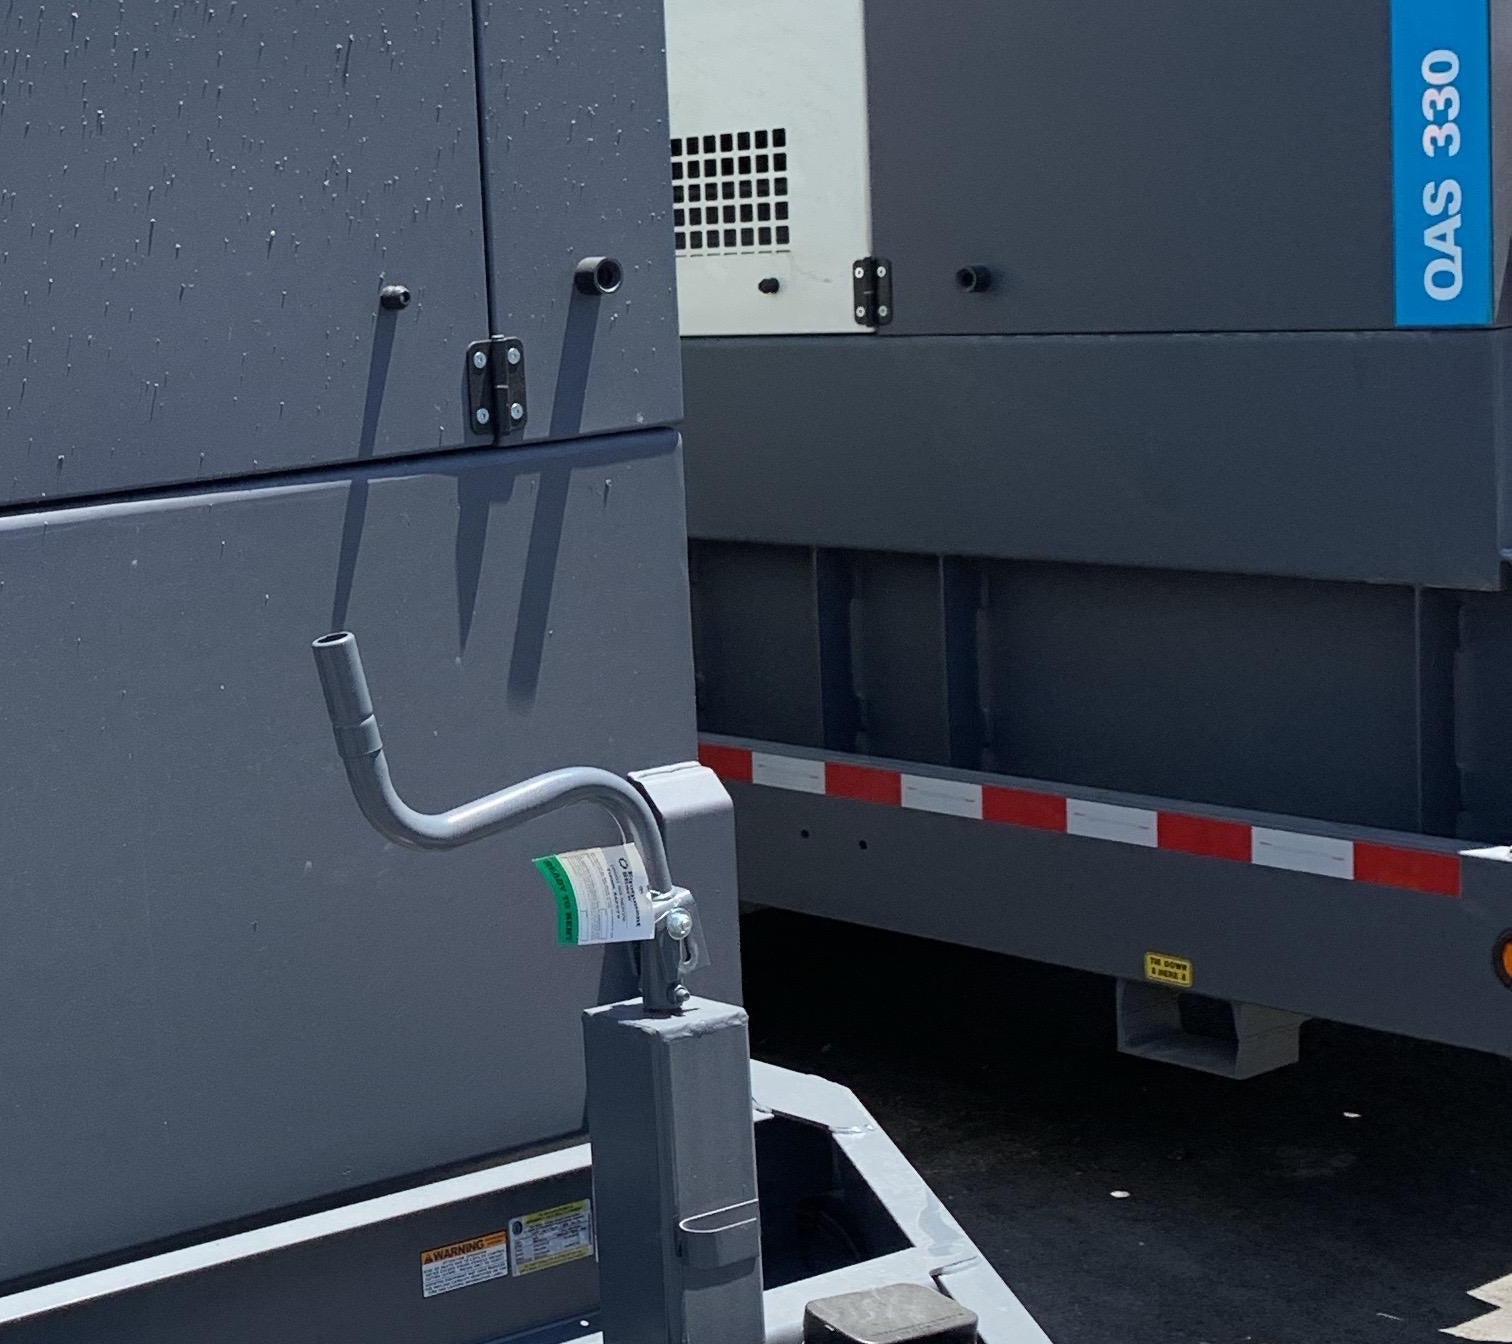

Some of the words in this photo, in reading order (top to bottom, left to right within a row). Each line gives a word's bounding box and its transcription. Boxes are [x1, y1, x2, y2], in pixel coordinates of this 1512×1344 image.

[1420, 49, 1461, 158] 330
[1422, 178, 1464, 302] QAS
[432, 1238, 485, 1262] WARNING
